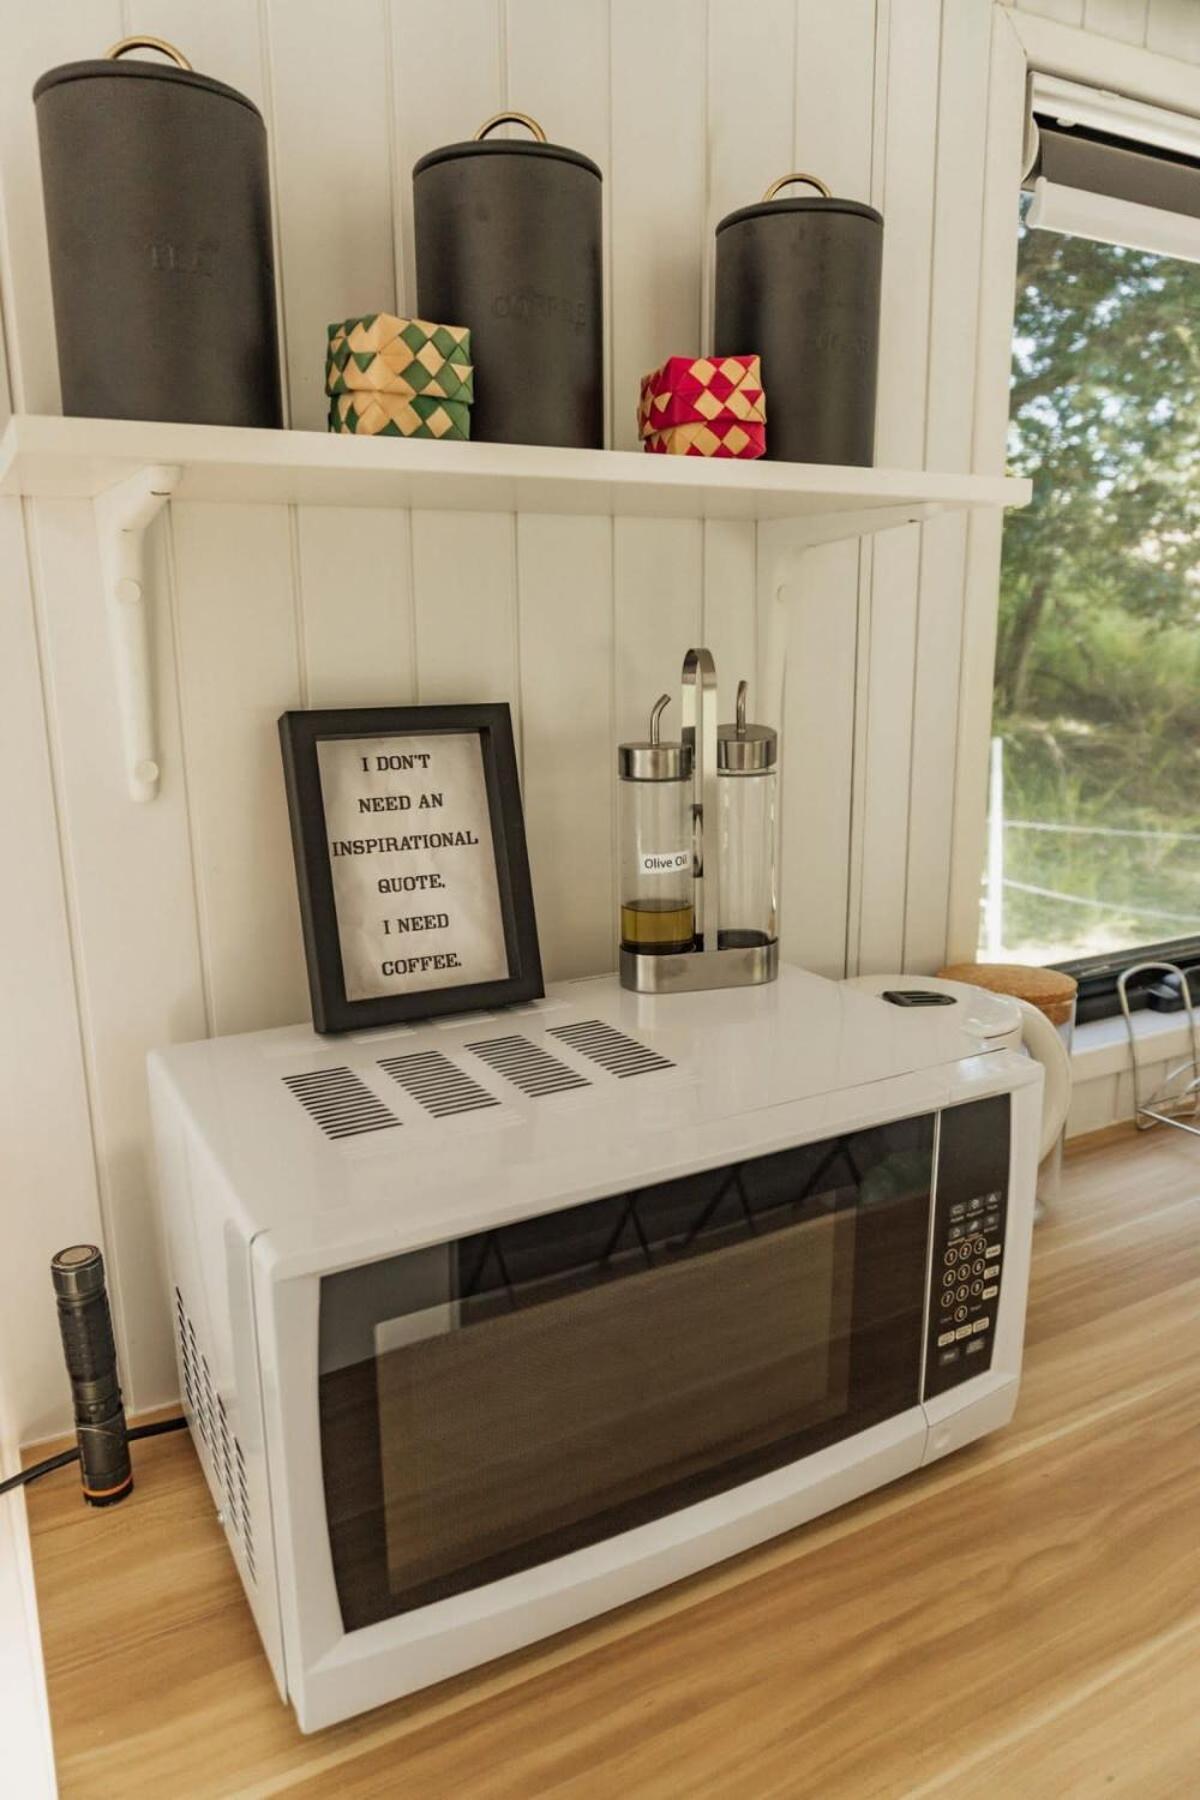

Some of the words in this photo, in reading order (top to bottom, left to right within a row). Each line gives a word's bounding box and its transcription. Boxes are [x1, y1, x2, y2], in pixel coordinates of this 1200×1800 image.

[362, 757, 369, 772] I
[377, 754, 431, 771] DON'T
[358, 795, 411, 813] NEED
[418, 793, 444, 810] AN
[332, 830, 479, 857] INSPIRATIONAL
[644, 858, 673, 869] Olive
[675, 854, 688, 866] Oil
[378, 874, 446, 894] QUOTE.
[383, 920, 391, 935] I
[398, 913, 449, 933] NEED
[381, 953, 462, 977] COFFEE.
